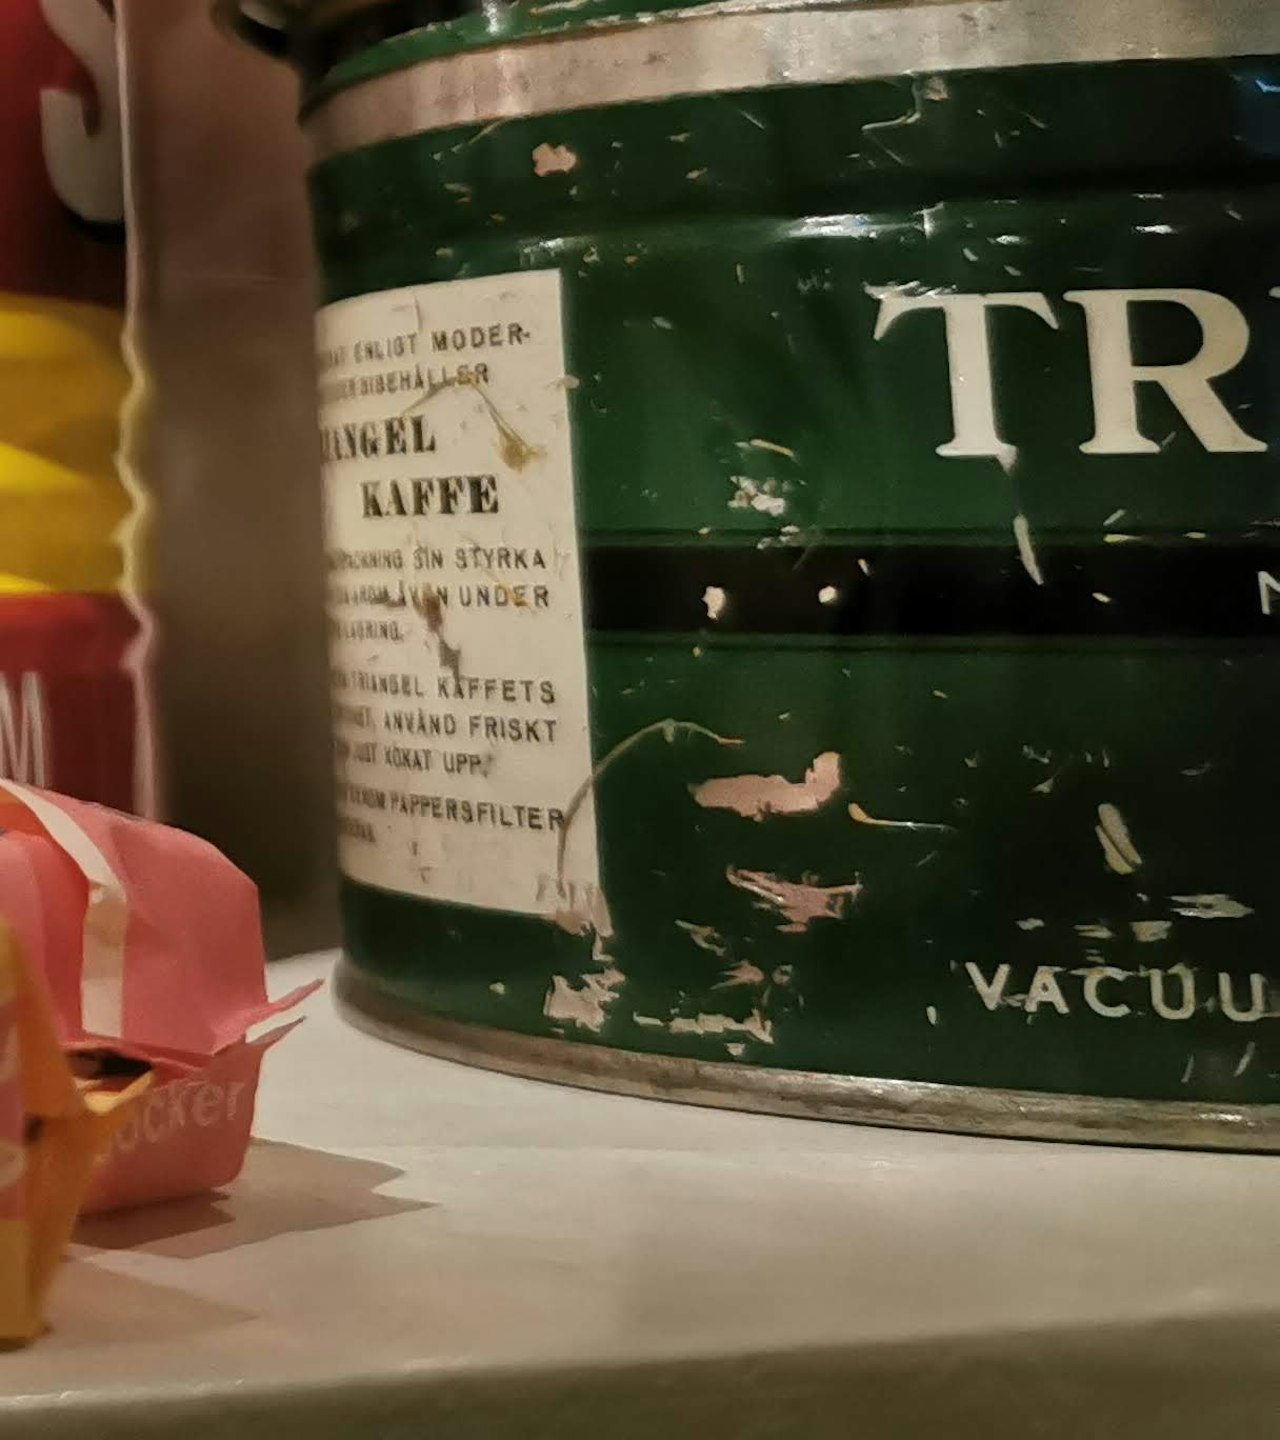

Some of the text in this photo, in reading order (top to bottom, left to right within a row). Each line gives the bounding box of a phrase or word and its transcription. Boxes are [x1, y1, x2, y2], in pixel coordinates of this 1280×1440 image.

[430, 322, 531, 354] MODER-
[360, 473, 500, 519] KAFFE
[455, 546, 547, 570] STYRKA
[458, 583, 550, 608] UNDER
[437, 674, 556, 705] KAFFETS
[469, 713, 558, 744] FRISKT
